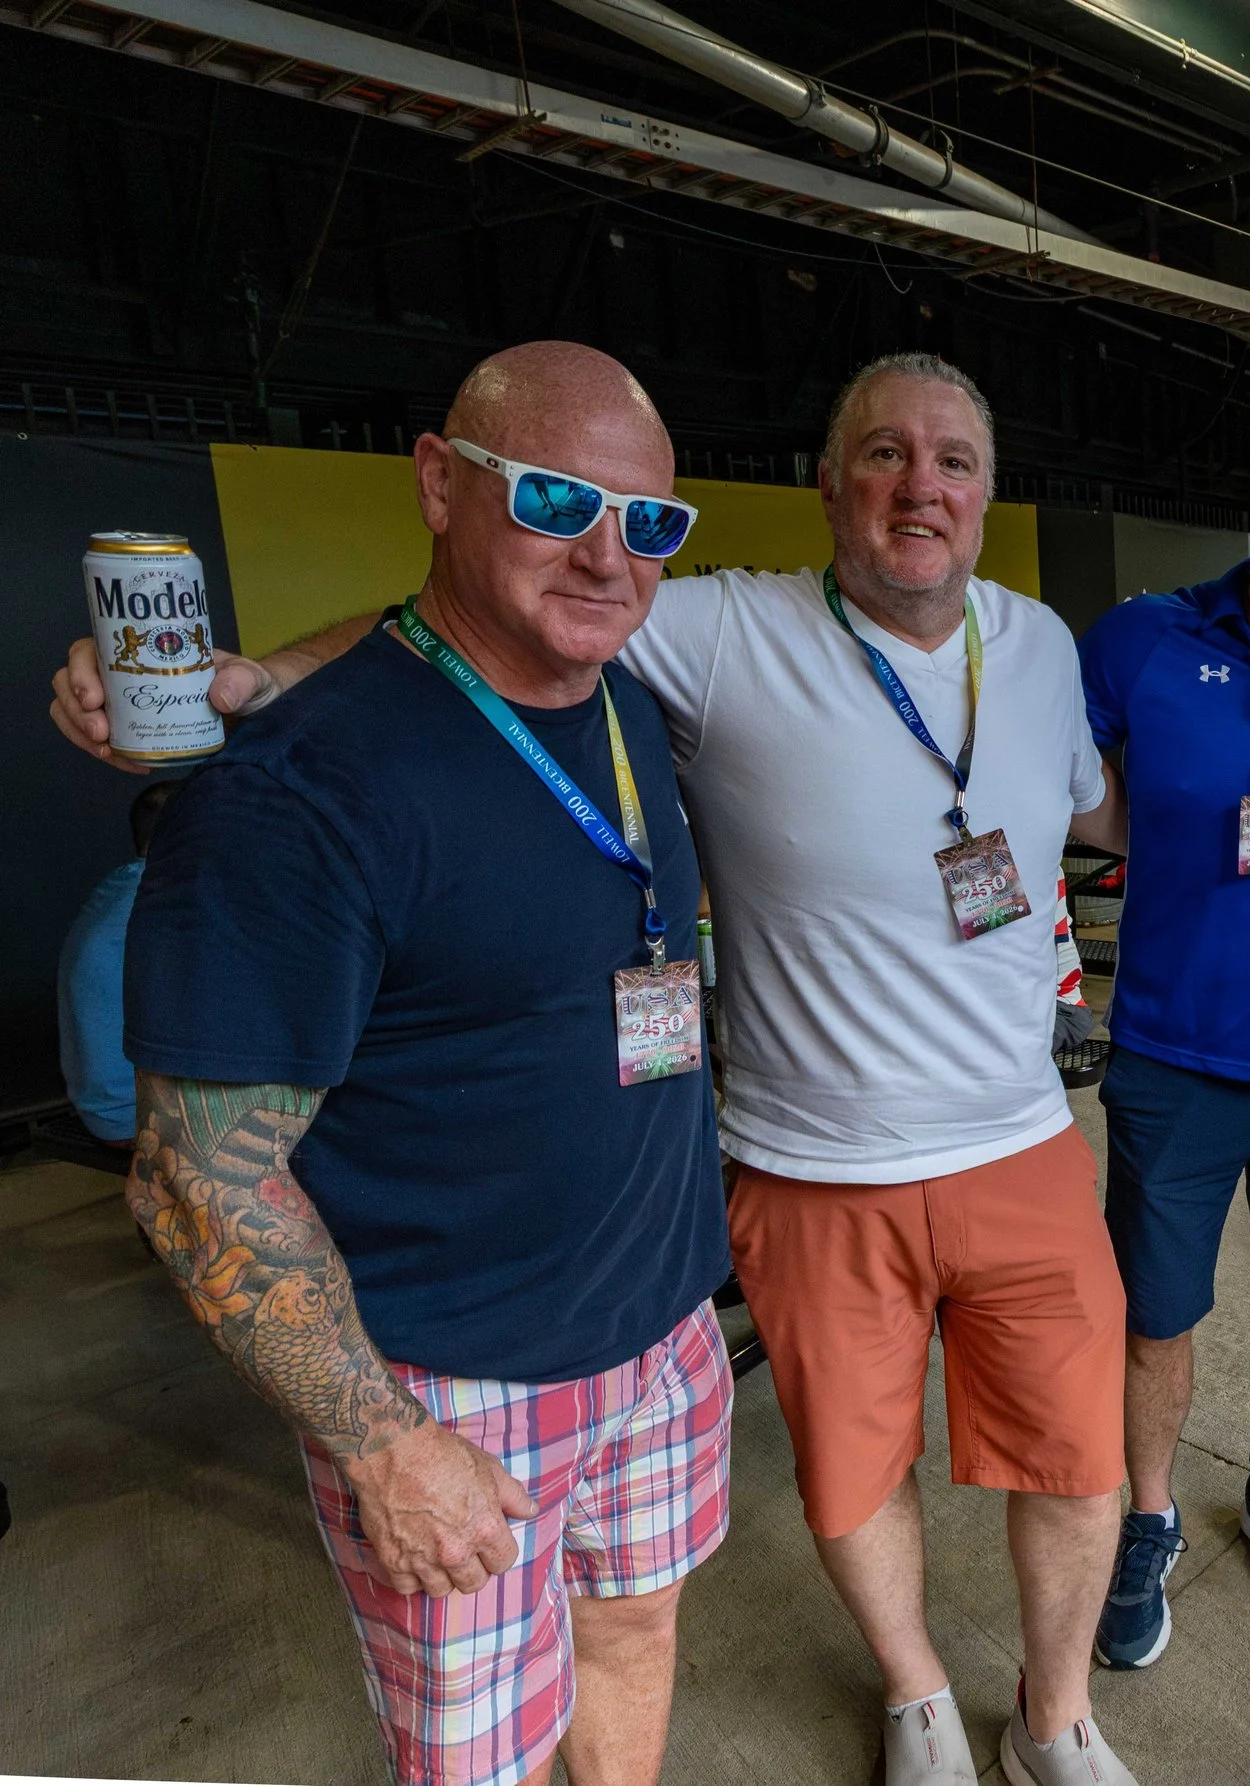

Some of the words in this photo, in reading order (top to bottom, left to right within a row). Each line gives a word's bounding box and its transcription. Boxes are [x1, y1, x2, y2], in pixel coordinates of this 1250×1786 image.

[133, 570, 185, 583] CERVEZA
[410, 625, 437, 651] 200
[437, 646, 477, 688] LOWELL
[123, 684, 209, 714] Especia
[899, 701, 919, 726] 200
[508, 720, 572, 795] BICENTENNIAL
[611, 741, 627, 766] 200
[568, 796, 598, 826] 200
[617, 770, 640, 844] BICENTENNIAL
[597, 823, 631, 864] LOWELL
[962, 874, 1006, 904] 250
[972, 916, 990, 928] JULY
[1001, 905, 1018, 916] 2026
[622, 986, 693, 1015] USA
[631, 1013, 684, 1041] 250
[629, 1044, 650, 1052] YEARS
[632, 1060, 653, 1072] JULY
[667, 1054, 687, 1064] 2026
